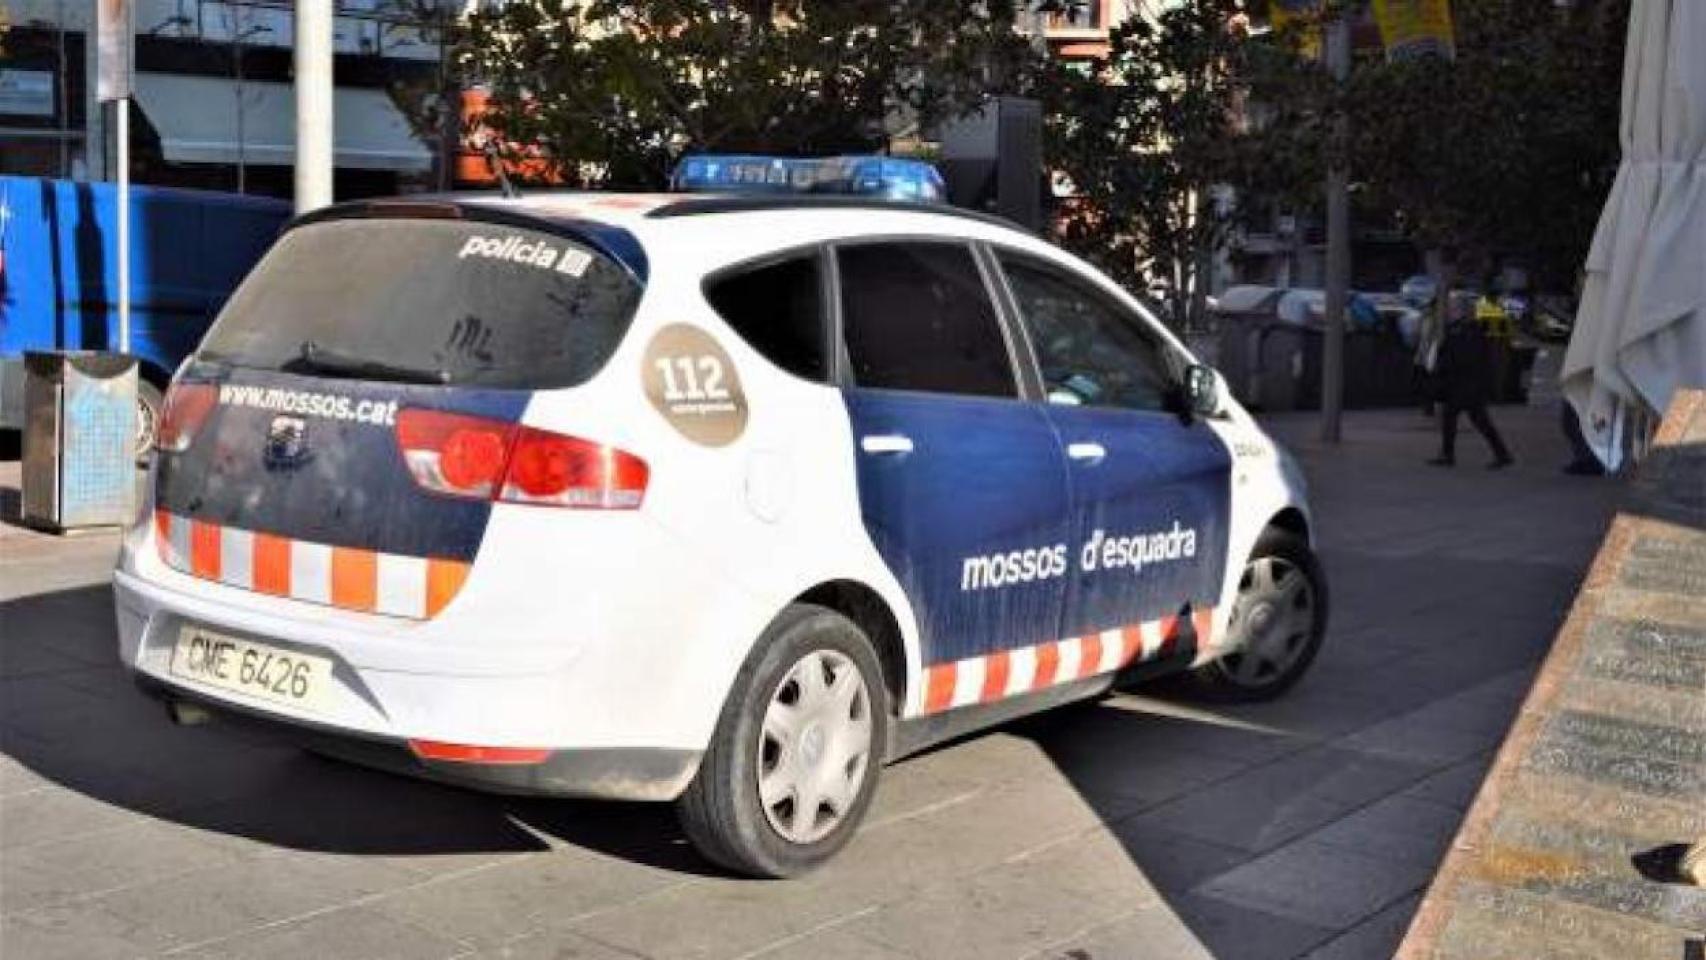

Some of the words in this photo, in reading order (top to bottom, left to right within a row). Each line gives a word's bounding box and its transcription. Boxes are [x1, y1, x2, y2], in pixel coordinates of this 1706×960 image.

[655, 354, 730, 400] 112
[219, 384, 398, 426] www.mossos.cat
[960, 543, 1067, 590] mossos
[1080, 520, 1197, 572] d'esquadra
[189, 635, 236, 679] CME
[239, 648, 310, 699] 6426
